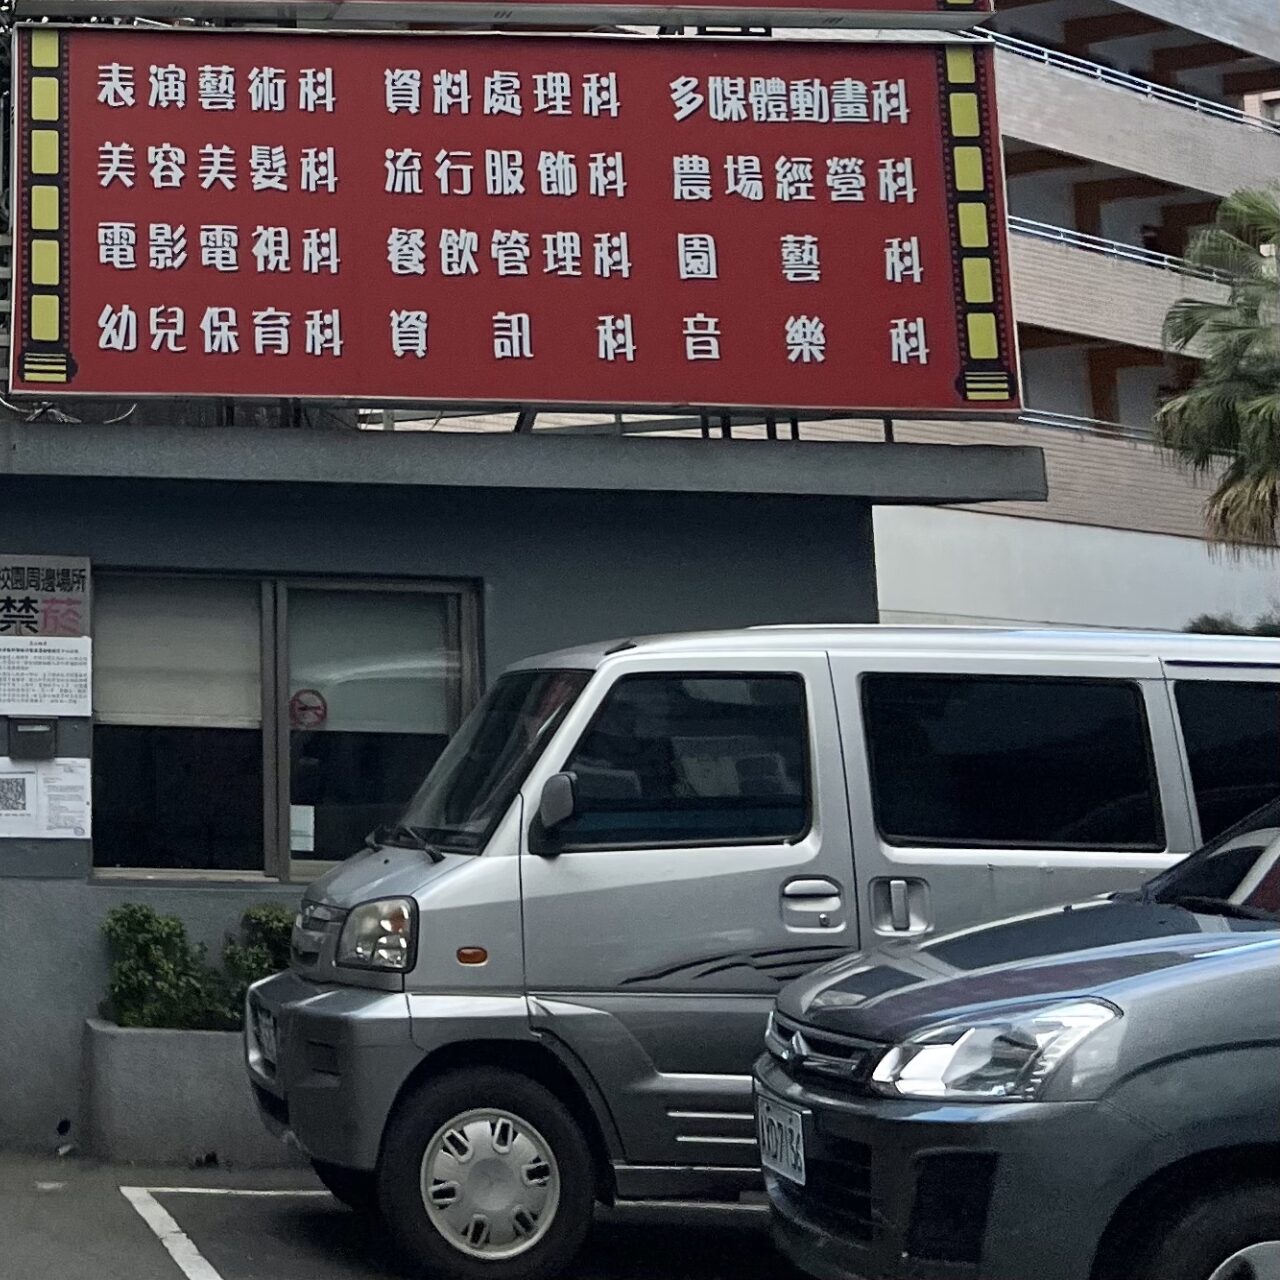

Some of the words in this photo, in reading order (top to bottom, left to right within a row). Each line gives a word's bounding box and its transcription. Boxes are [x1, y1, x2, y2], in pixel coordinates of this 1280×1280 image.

[97, 62, 337, 112] 表演藝術科
[384, 68, 621, 118] 資料處理科
[670, 75, 910, 124] 多媒體動畫科
[97, 141, 339, 193] 美容美髮科
[384, 147, 628, 198] 流行服飾科
[673, 154, 918, 204] 農場經營科
[98, 222, 341, 274] 電影電視科
[387, 227, 632, 279] 餐飲管理科
[677, 232, 924, 283] 園藝科
[98, 303, 344, 357] 幼兒保育科
[390, 308, 637, 362] 資訊科
[682, 313, 930, 365] 音樂科
